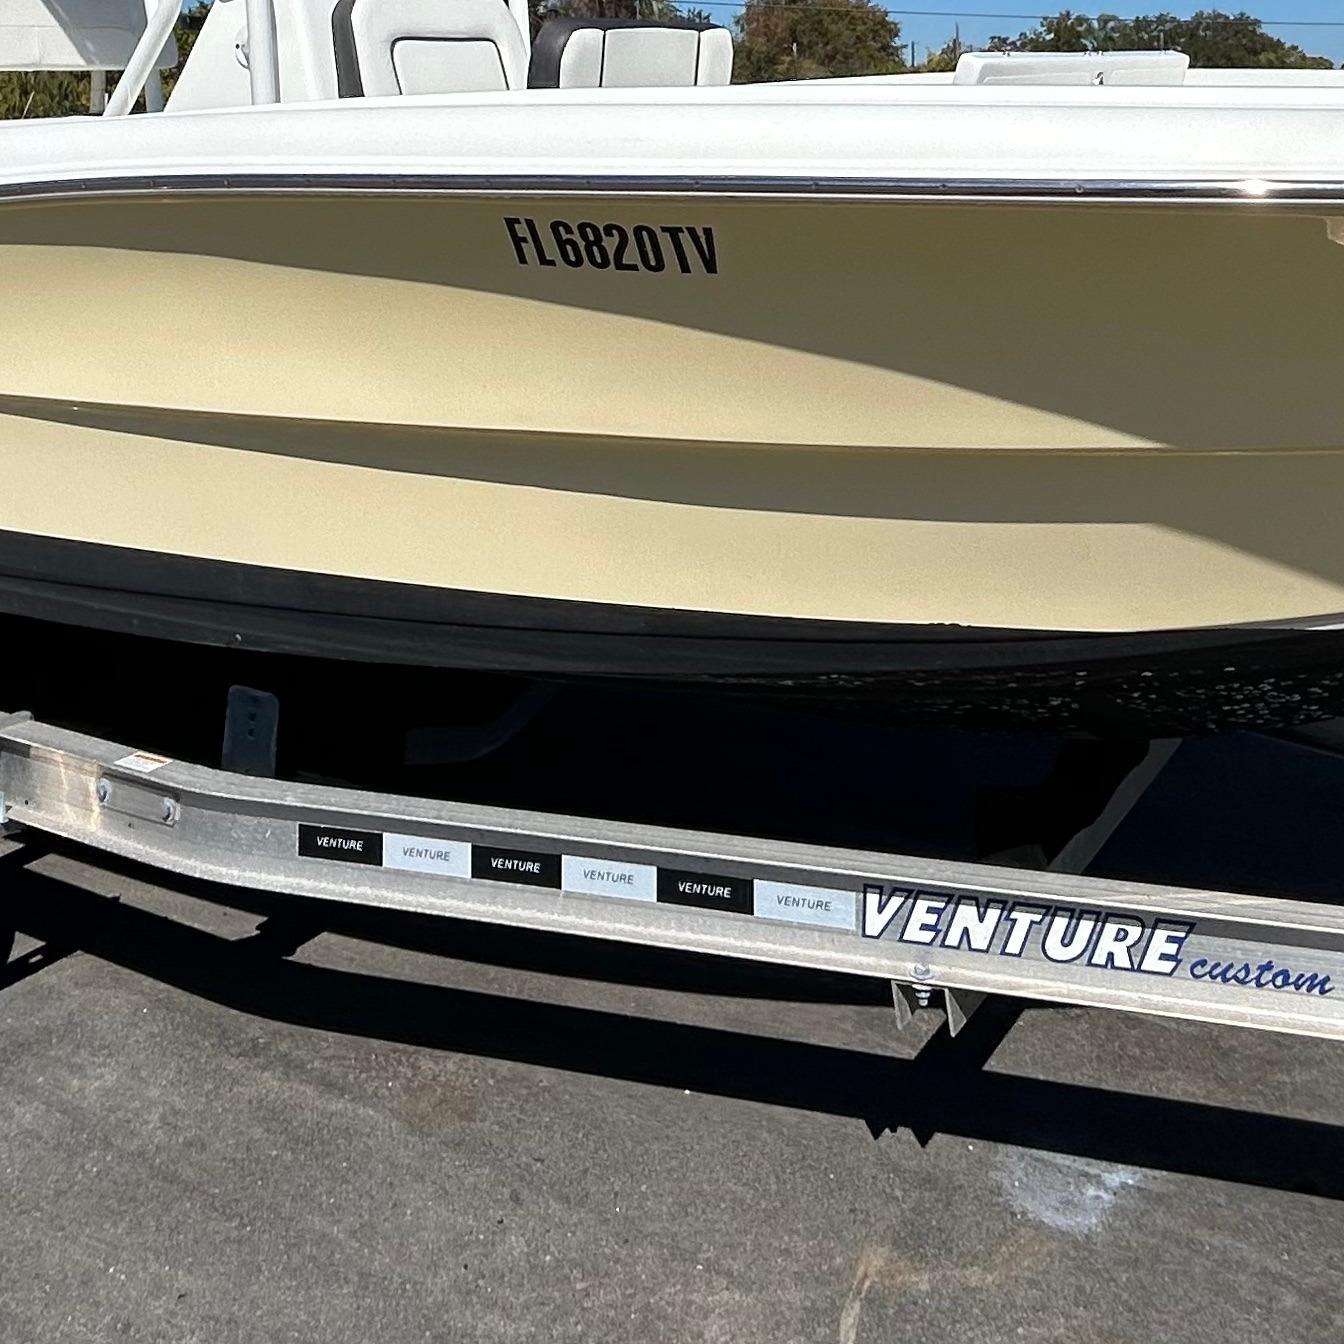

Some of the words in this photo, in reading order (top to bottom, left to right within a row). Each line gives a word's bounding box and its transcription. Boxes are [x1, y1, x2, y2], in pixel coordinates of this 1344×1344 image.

[503, 216, 719, 275] FL6820TV
[315, 835, 365, 853] VENTURE
[401, 845, 451, 863] VENTURE
[489, 856, 542, 875] VENTURE
[582, 868, 635, 886] VENTURE
[677, 880, 733, 899] VENTURE
[775, 894, 833, 913] VENTURE
[860, 883, 1197, 977] VENTURE
[1188, 954, 1337, 997] custom
